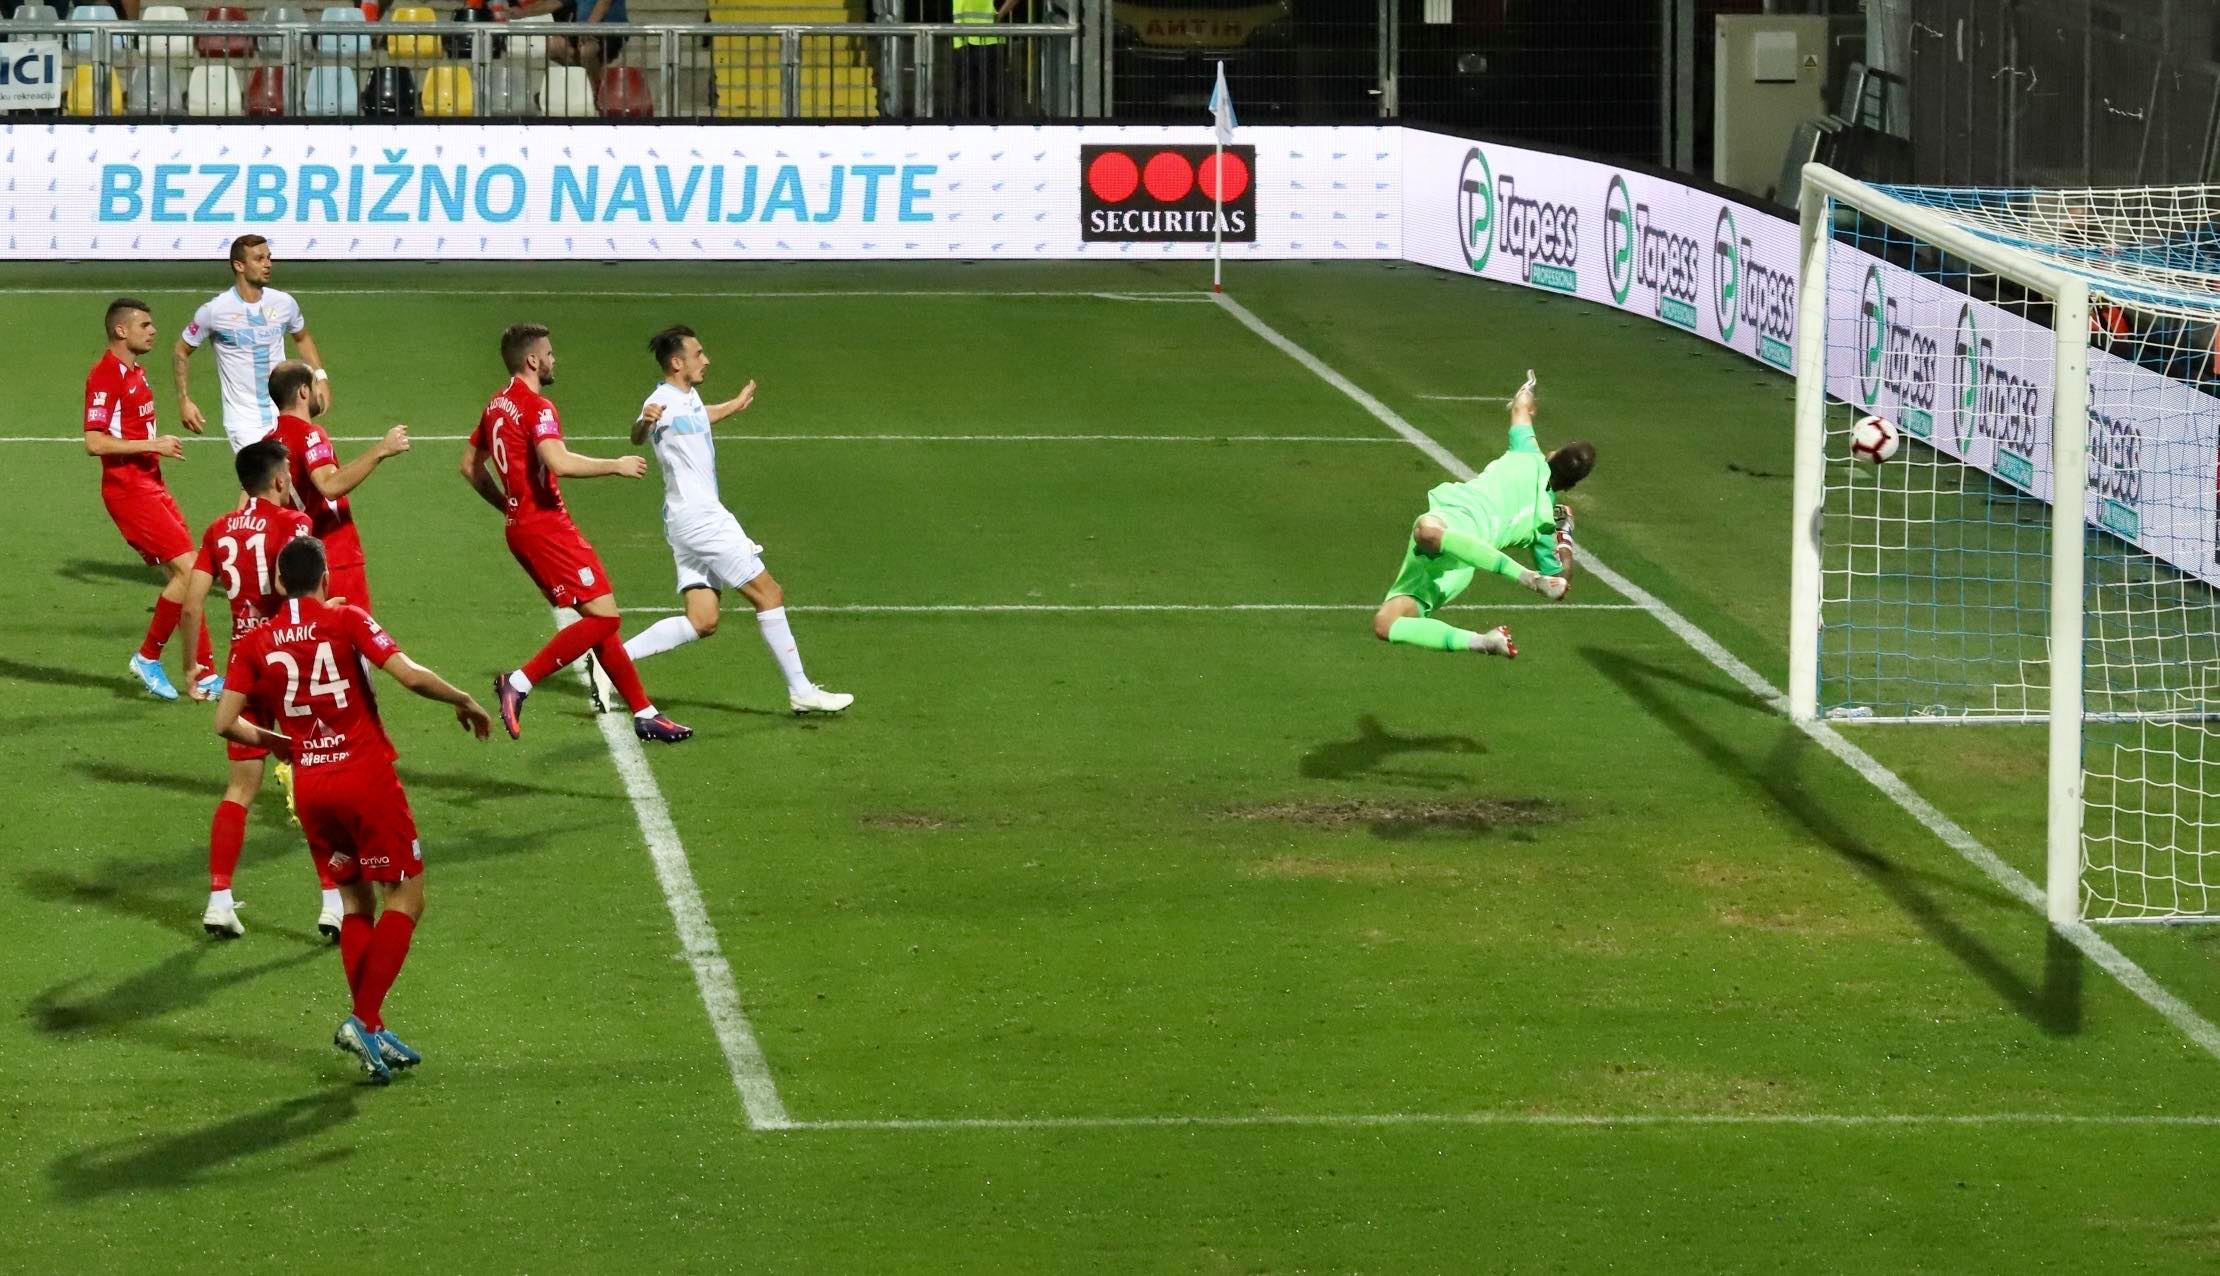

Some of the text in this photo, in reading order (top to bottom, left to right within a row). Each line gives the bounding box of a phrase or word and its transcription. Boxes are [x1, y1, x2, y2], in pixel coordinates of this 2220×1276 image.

[100, 149, 938, 223] BEZBRIŽNO NAVIJAJTE
[1091, 209, 1246, 233] SECURITAS
[1498, 174, 1578, 282] Tapess
[1636, 203, 1698, 317] Tapess
[1741, 237, 1795, 356] Tapess
[492, 416, 508, 474] 6
[217, 533, 272, 600] 31
[272, 621, 317, 647] MARIĆ
[265, 641, 351, 717] 24
